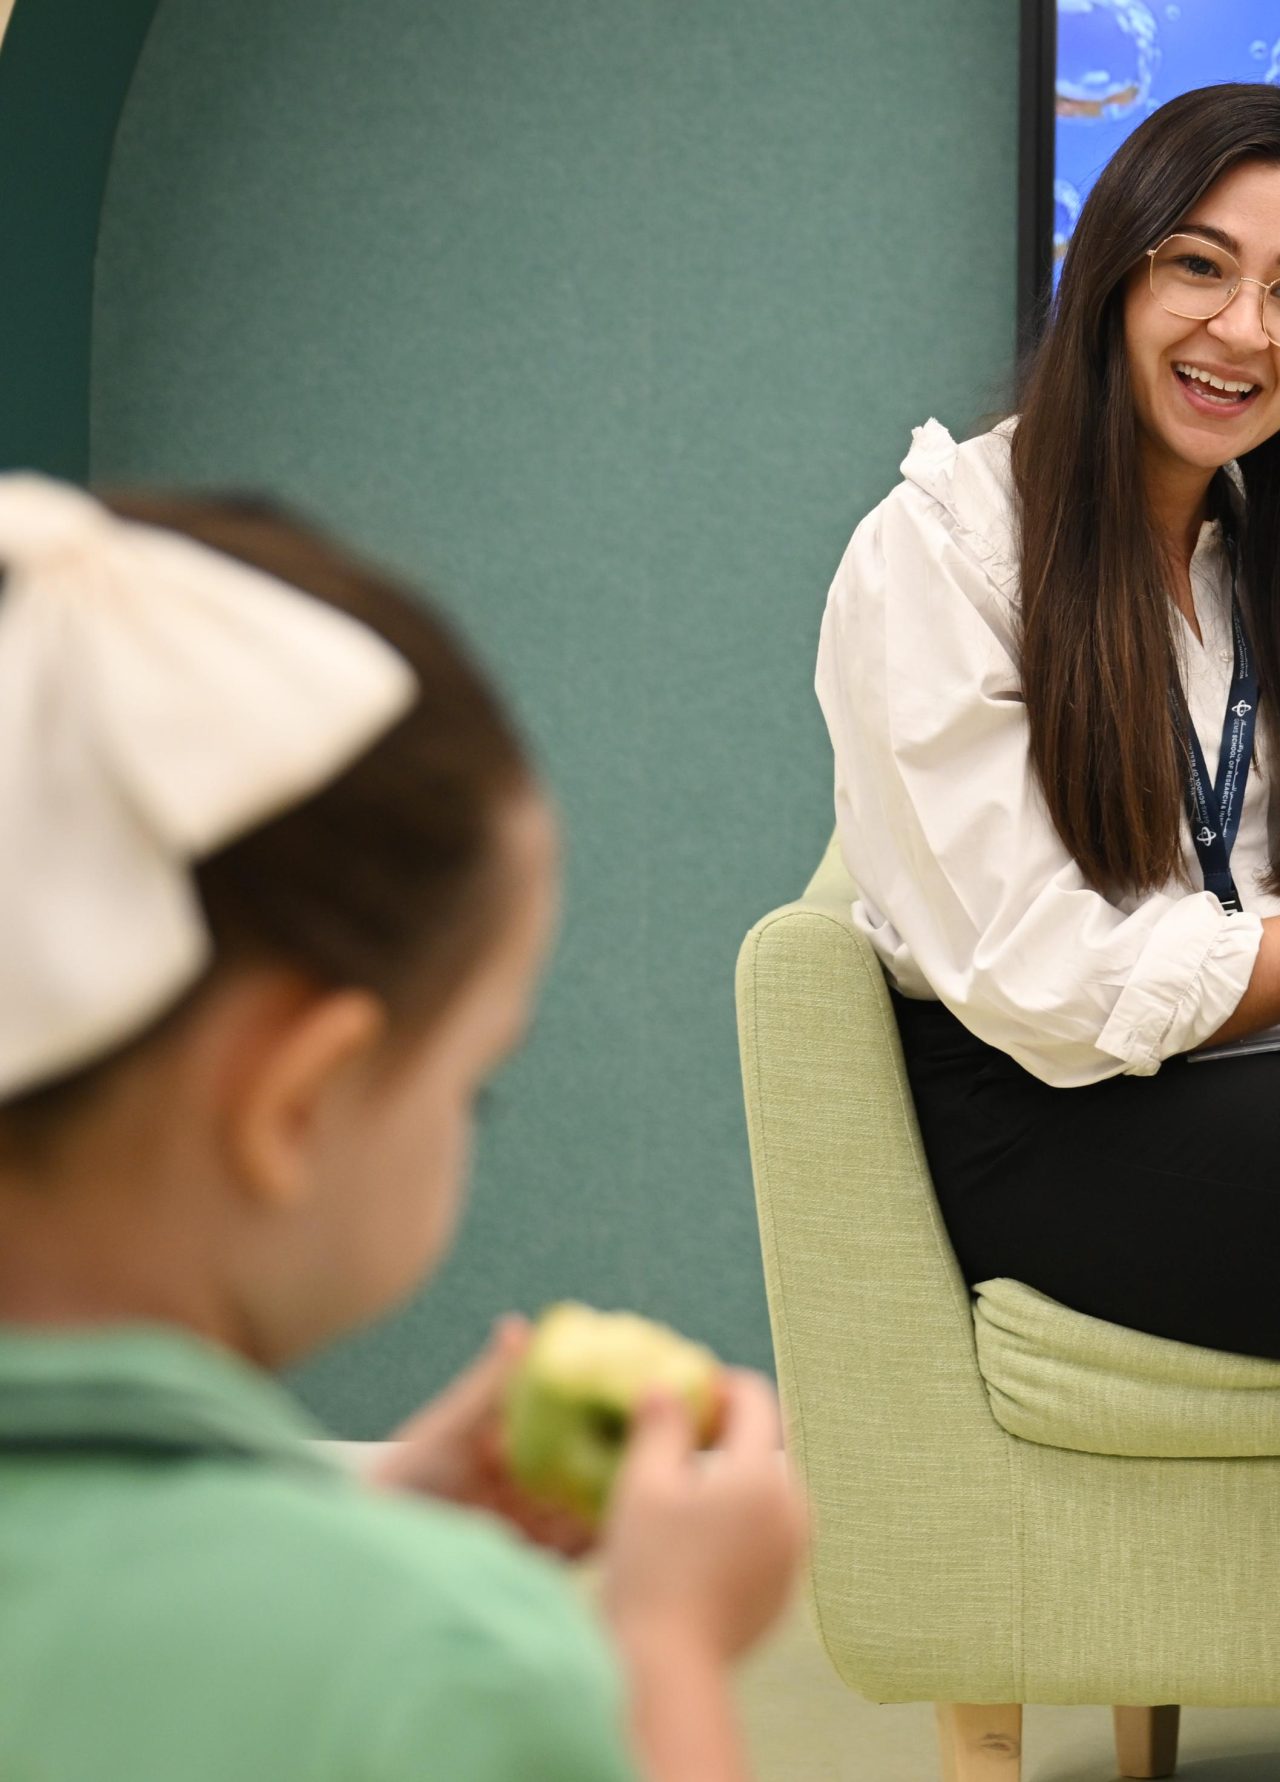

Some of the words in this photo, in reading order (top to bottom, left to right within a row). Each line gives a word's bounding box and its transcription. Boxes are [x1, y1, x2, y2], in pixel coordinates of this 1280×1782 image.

[1229, 734, 1239, 760] SCHOOL
[1227, 760, 1236, 771] OF
[1195, 778, 1206, 805] SCHOOL
[1221, 770, 1233, 805] RESEARCH
